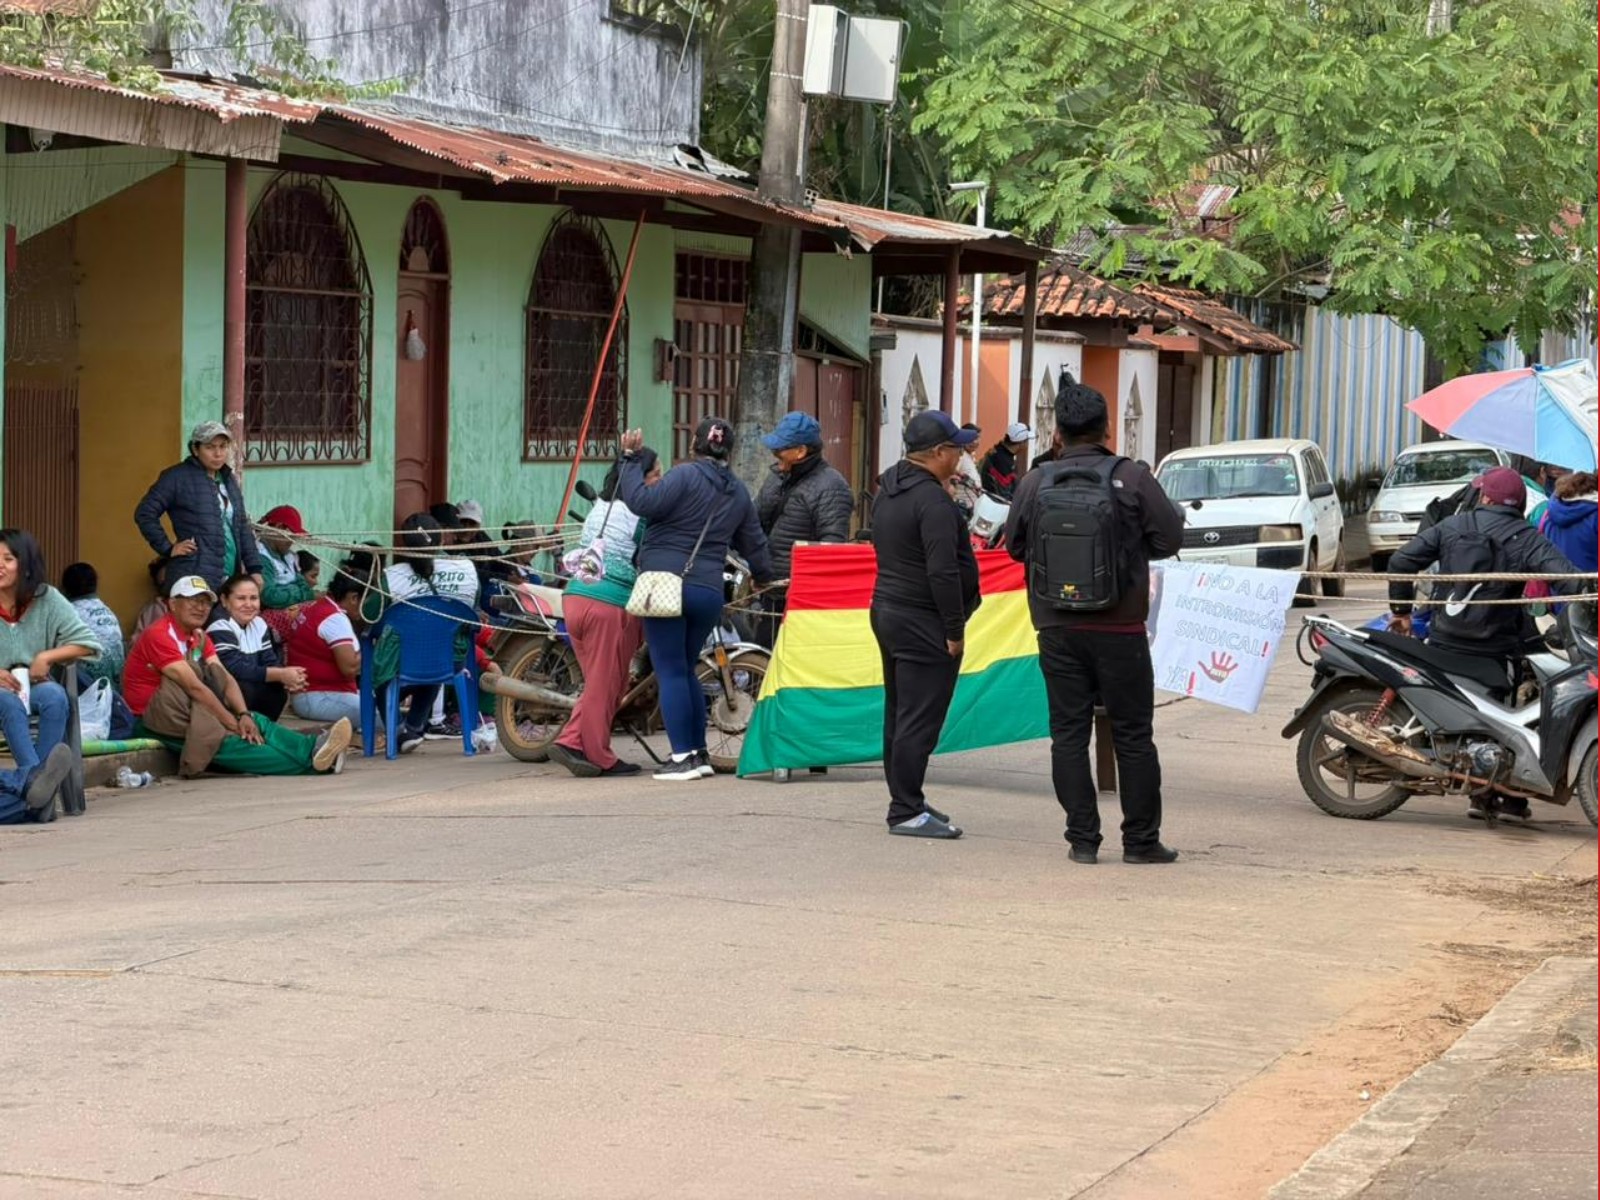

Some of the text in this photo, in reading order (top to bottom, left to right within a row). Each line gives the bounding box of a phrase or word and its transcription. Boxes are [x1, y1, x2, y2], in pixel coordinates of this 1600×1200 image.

[408, 571, 465, 587] DITRITO
[1235, 579, 1251, 597] A
[1255, 582, 1279, 604] LA
[1174, 619, 1269, 658] SINDICAL!
